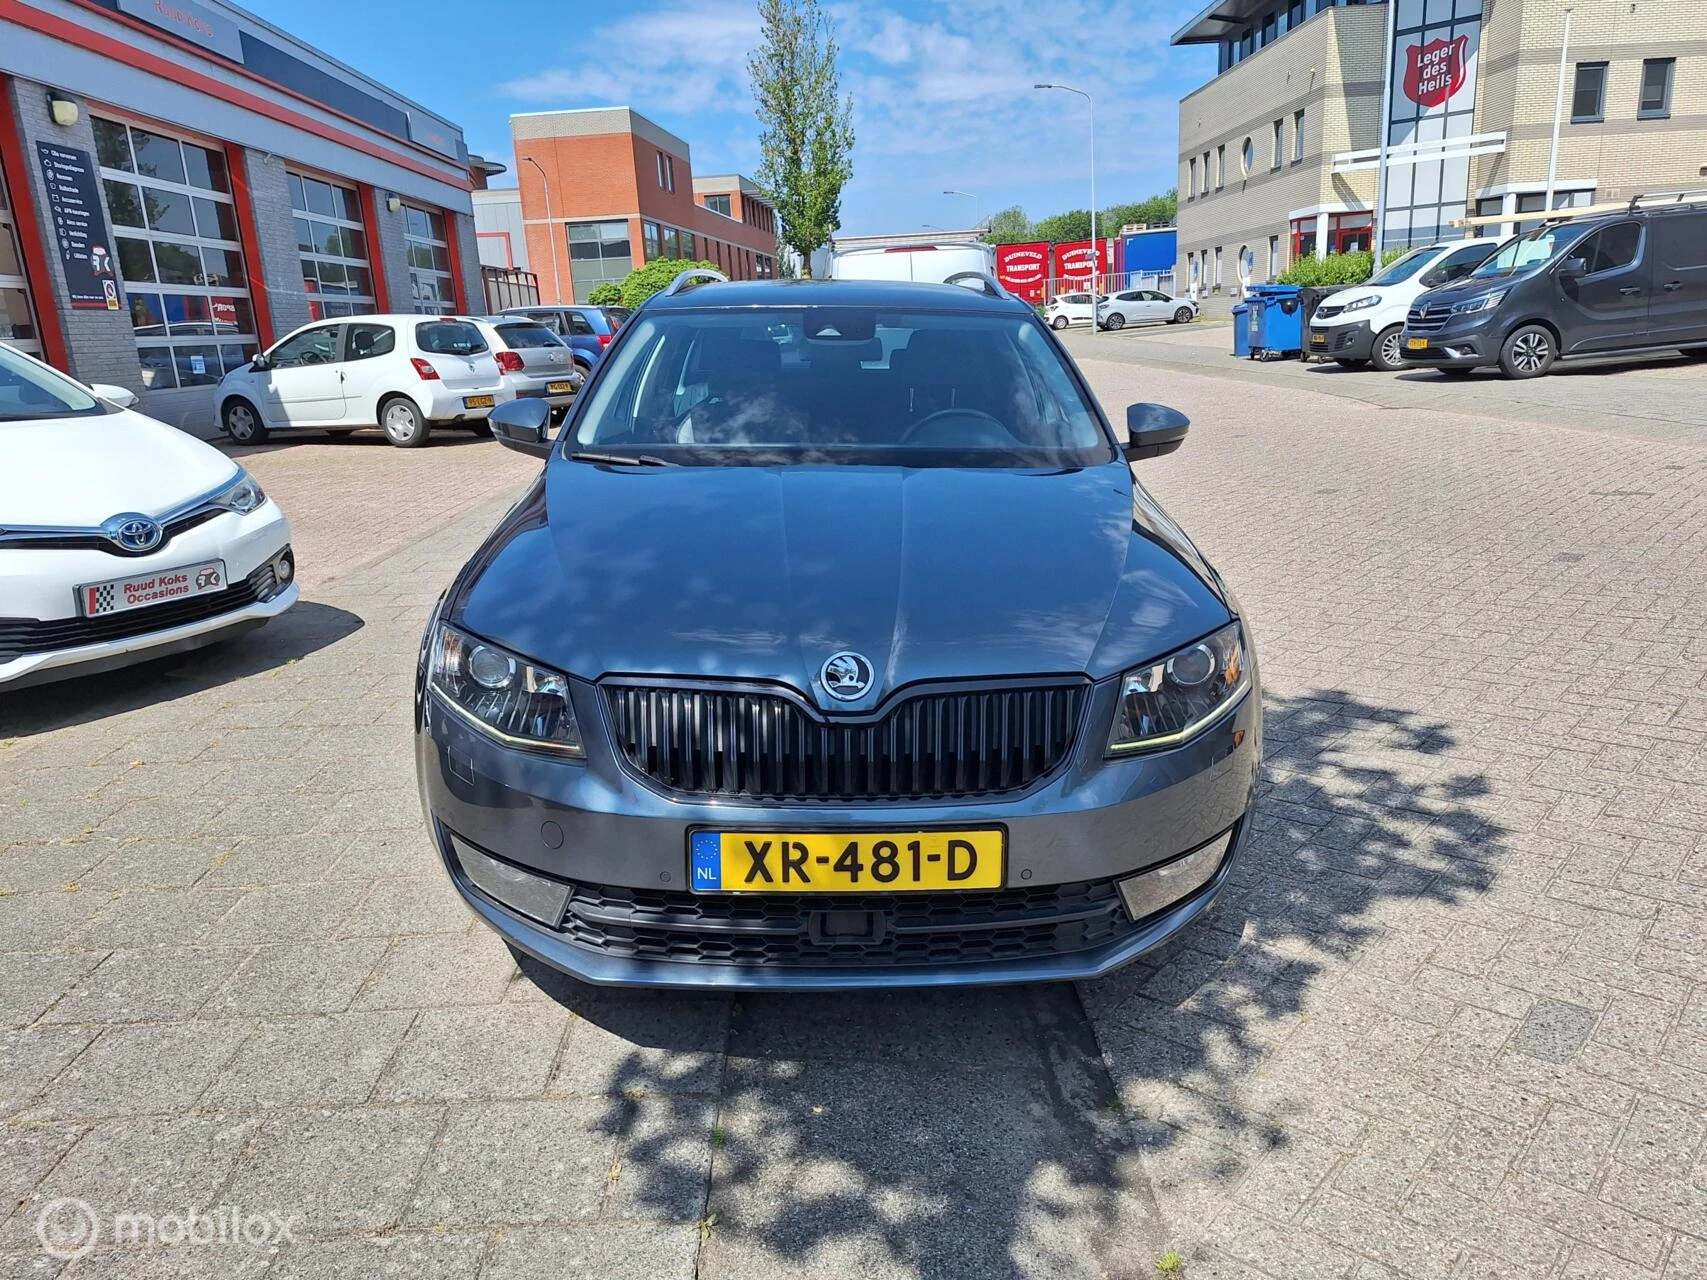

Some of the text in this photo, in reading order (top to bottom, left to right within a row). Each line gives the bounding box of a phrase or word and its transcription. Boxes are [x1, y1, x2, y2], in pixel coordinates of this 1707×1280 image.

[1417, 44, 1455, 67] Leger
[1423, 61, 1447, 79] des
[1418, 74, 1452, 95] Heils
[1004, 250, 1042, 262] DUINEVELD
[1062, 248, 1100, 260] DUINEVED
[1006, 263, 1040, 272] TRANSPORT
[124, 579, 155, 594] Ruud
[158, 574, 188, 587] Koks
[127, 584, 189, 604] Occasions
[743, 839, 977, 883] XR-481-D
[697, 867, 716, 881] NL
